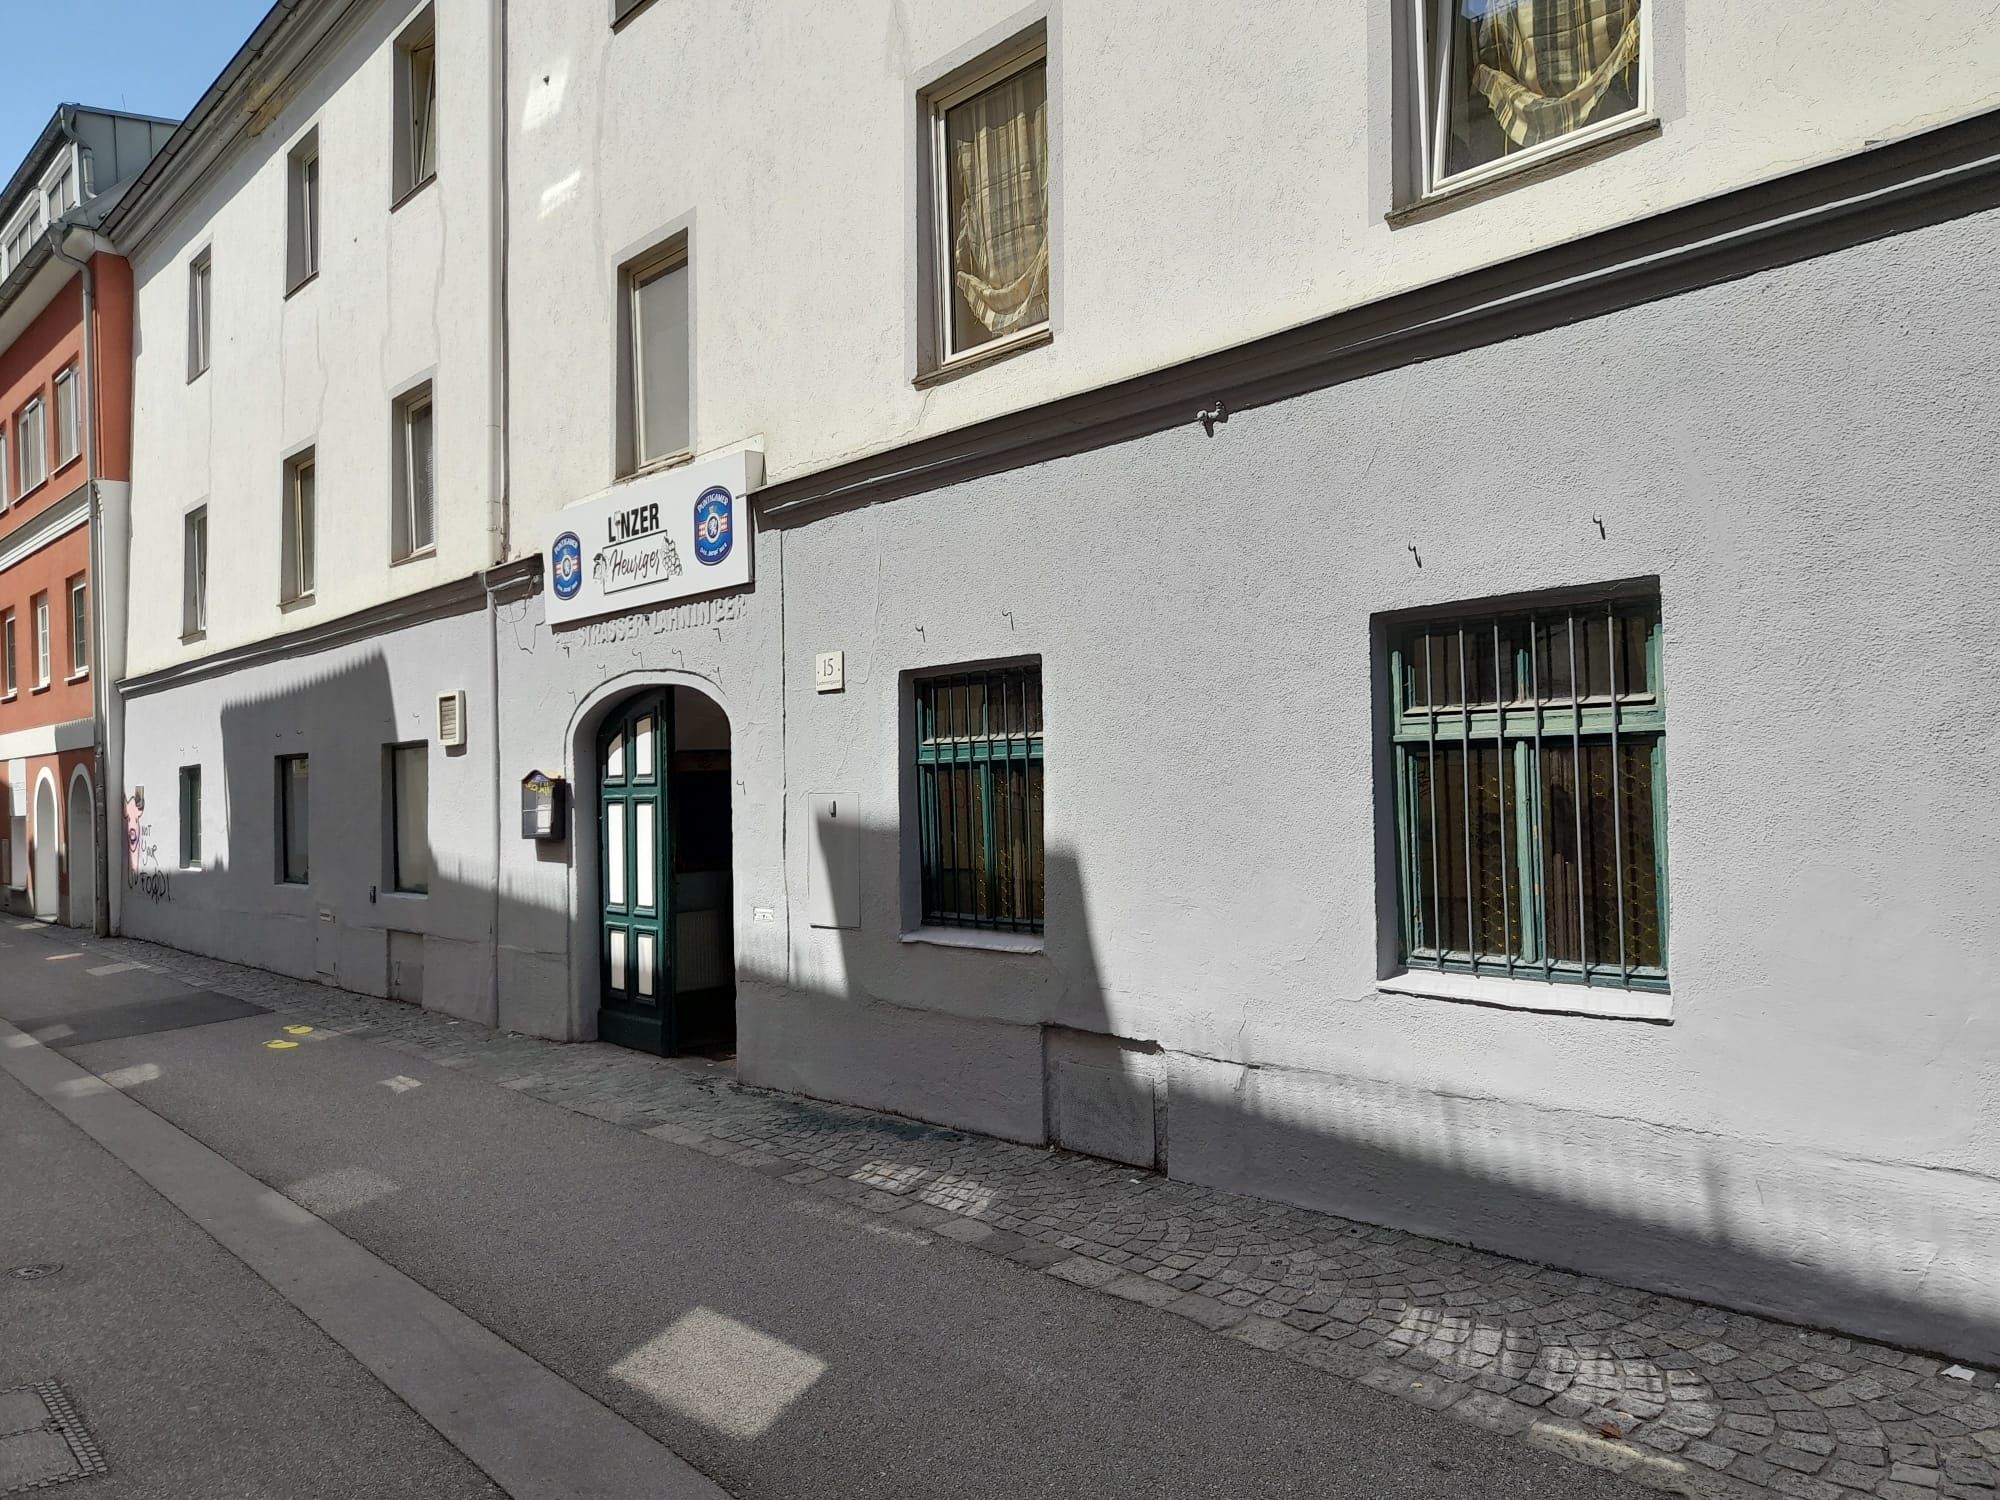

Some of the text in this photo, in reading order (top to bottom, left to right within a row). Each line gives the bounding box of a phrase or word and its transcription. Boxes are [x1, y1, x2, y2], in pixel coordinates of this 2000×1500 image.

[697, 493, 729, 513] PUNTIGAMER
[823, 658, 833, 676] 15
[142, 825, 152, 837] NOT
